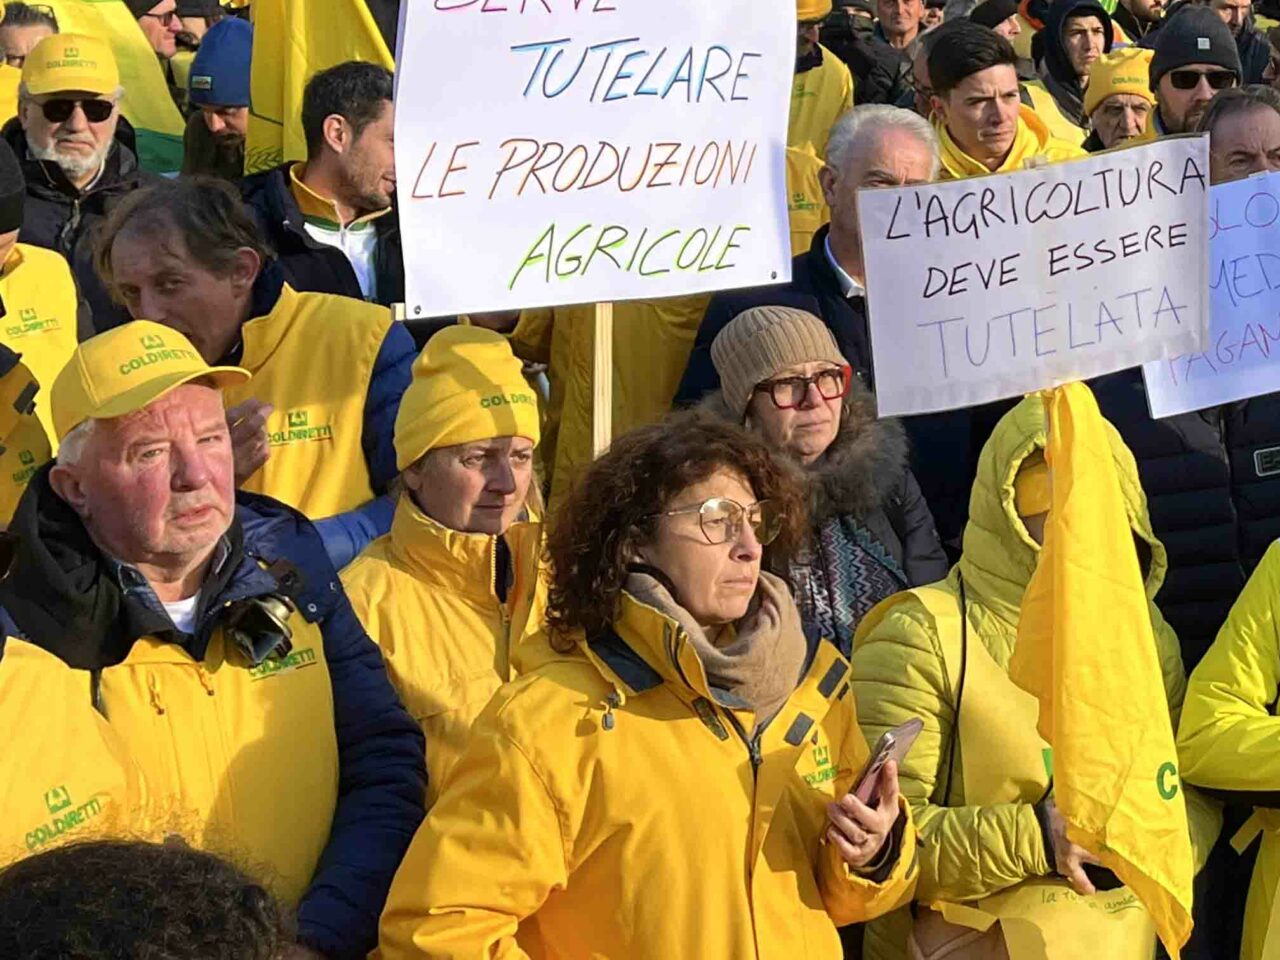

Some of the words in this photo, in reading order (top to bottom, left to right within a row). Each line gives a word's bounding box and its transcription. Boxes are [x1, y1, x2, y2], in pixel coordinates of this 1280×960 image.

[510, 36, 763, 103] TUTELARE
[410, 140, 480, 201] LE
[488, 137, 757, 201] PRODUZIONI
[886, 156, 1208, 241] L'AGRICOLTURA
[508, 222, 751, 292] AGRICOLE
[922, 252, 1022, 300] DEVE
[1049, 223, 1189, 277] ESSERE
[916, 286, 1189, 379] TUTELATA
[25, 798, 101, 849] COLDIRETTI
